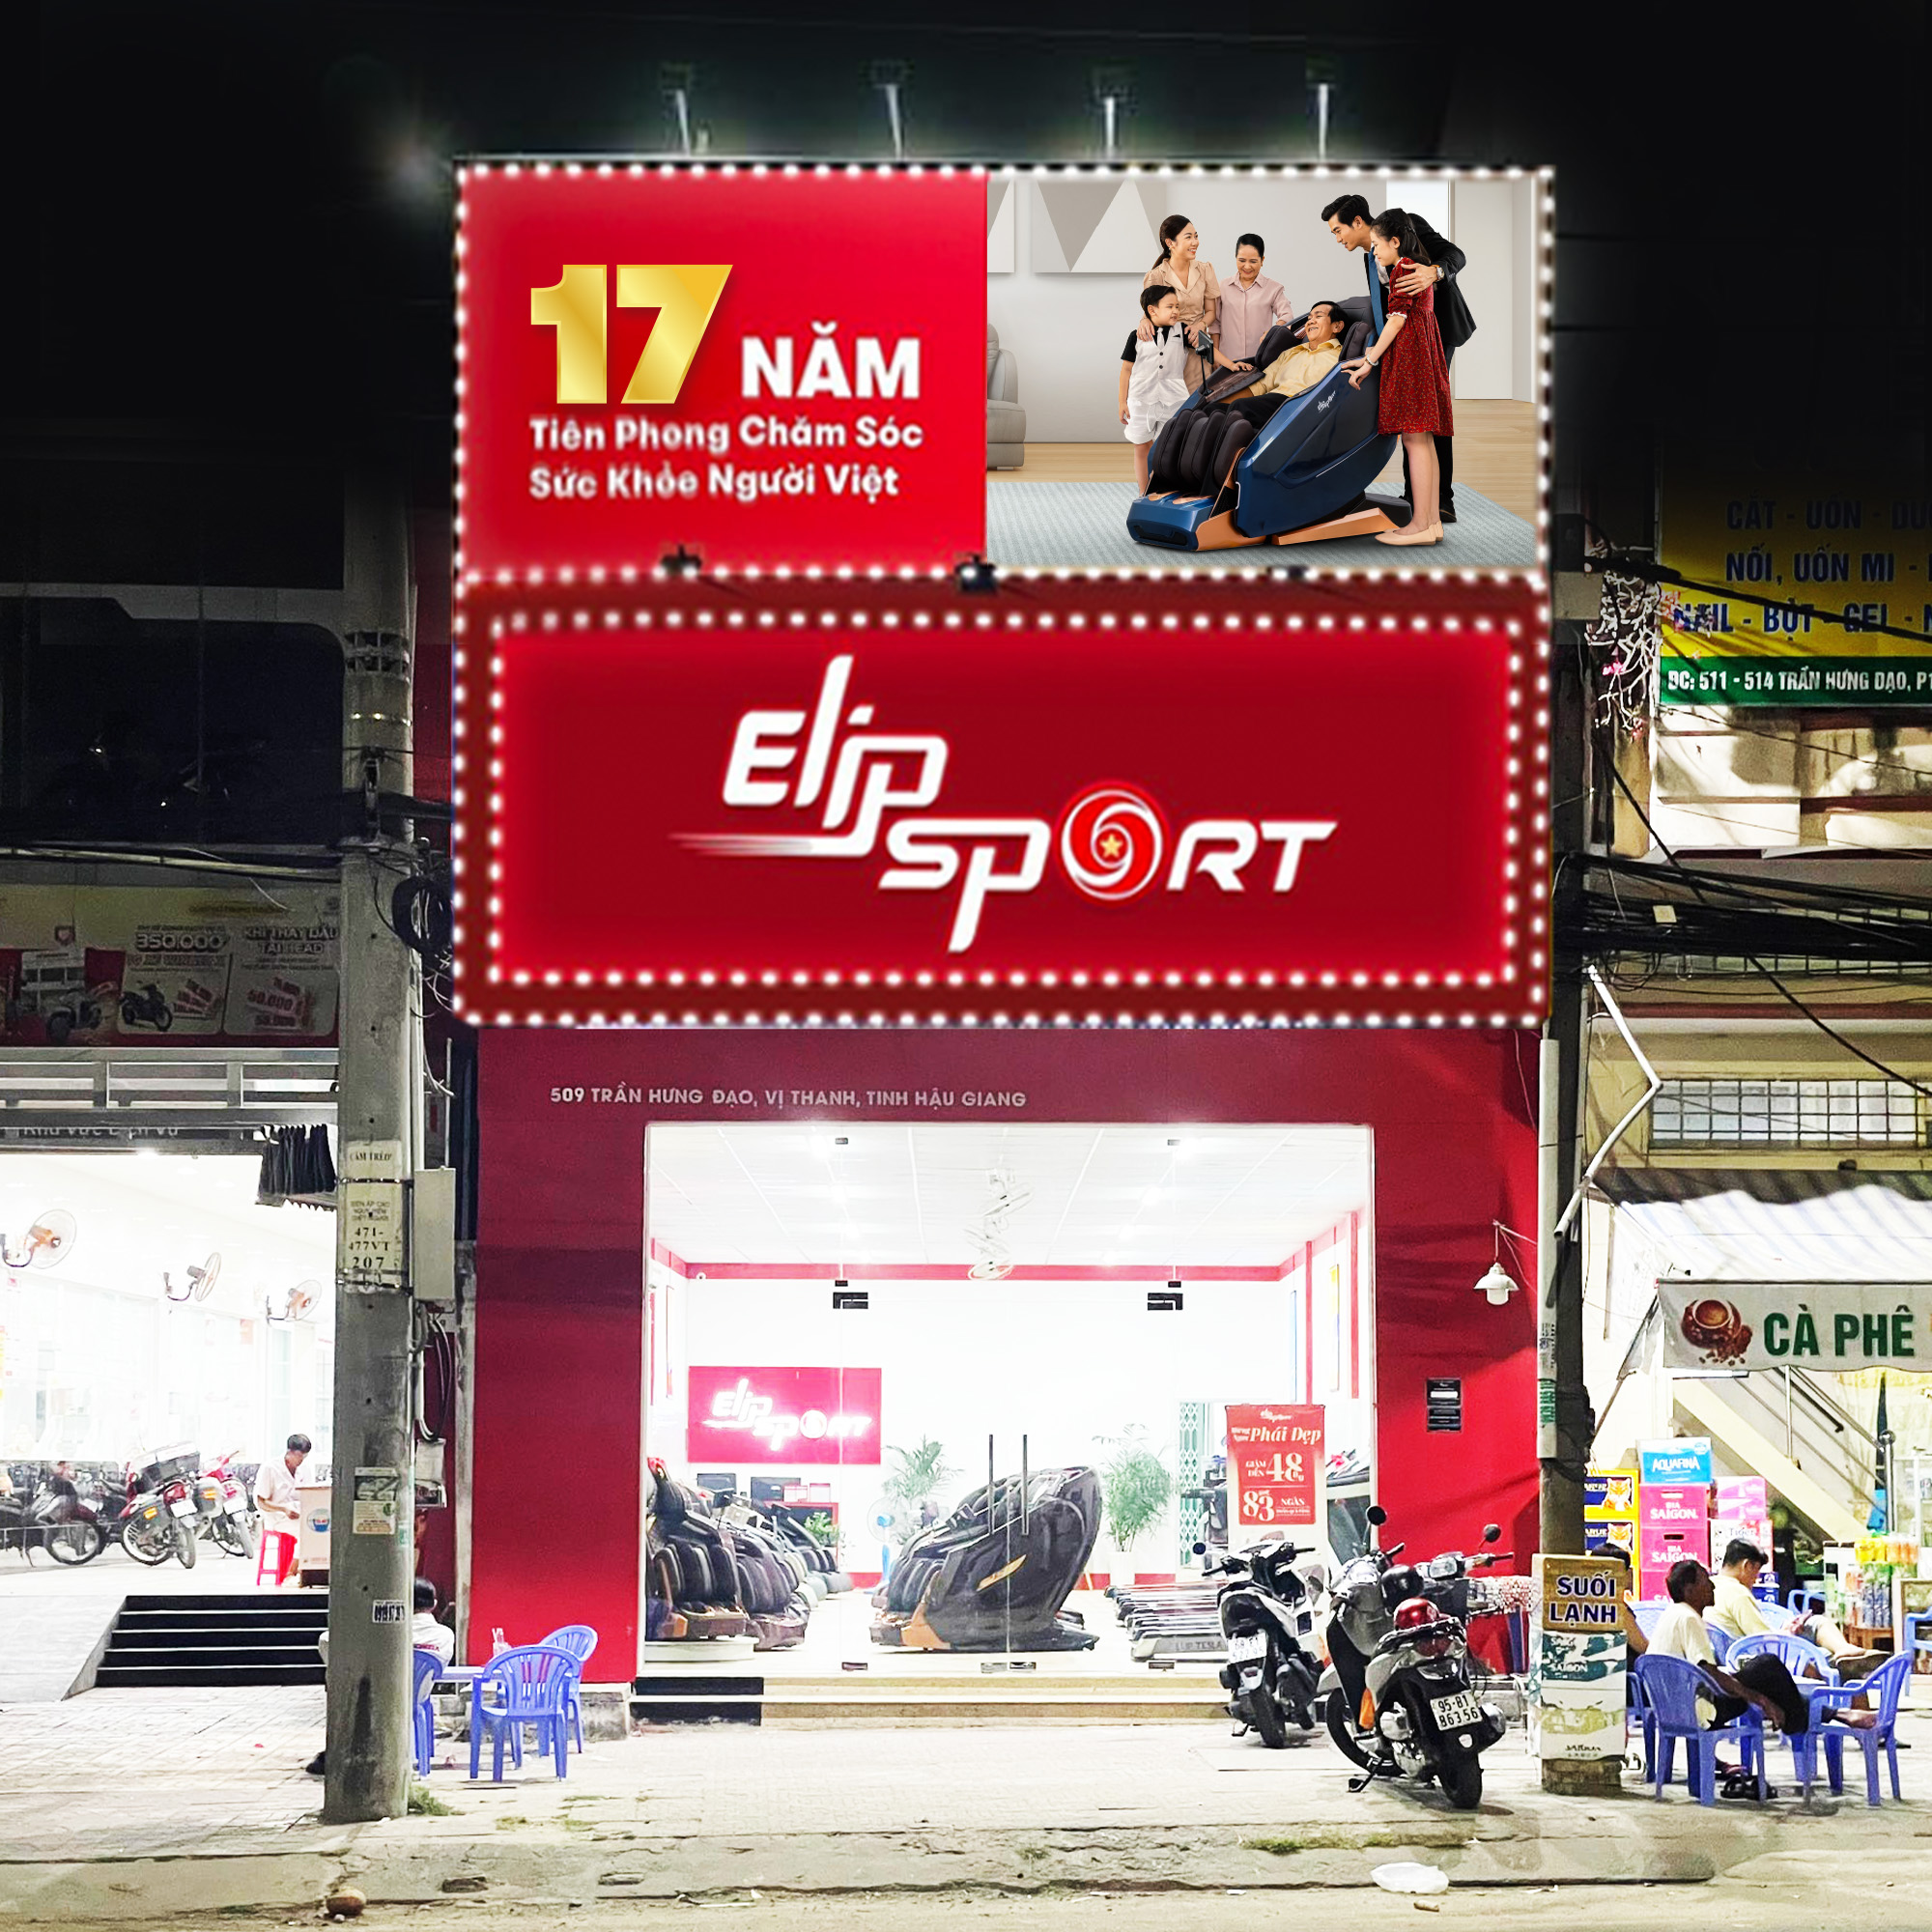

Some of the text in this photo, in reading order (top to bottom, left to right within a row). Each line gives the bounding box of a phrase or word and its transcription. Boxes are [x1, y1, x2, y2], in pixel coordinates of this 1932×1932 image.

[530, 265, 921, 404] 17 NĂM
[529, 415, 923, 455] Tiên Phong Chăm Sóc
[529, 461, 899, 503] Sức Khỏe Người Việt
[1794, 543, 1849, 582] UỐN
[1861, 554, 1893, 582] MI
[1699, 670, 1727, 691] 511
[1744, 670, 1775, 691] 514
[550, 1087, 585, 1103] 509
[590, 1081, 642, 1103] TRẦN
[648, 1087, 703, 1104] HƯNG
[765, 1090, 784, 1109] VỊ
[790, 1090, 861, 1107] THANH,
[915, 1087, 954, 1110] HẬU
[961, 1091, 1027, 1107] GIANG
[353, 1256, 385, 1269] 207
[1764, 1303, 1916, 1357] CÀ PHÊ
[1652, 1456, 1700, 1472] AQUAFINA
[1242, 1491, 1275, 1522] 83
[1557, 1571, 1616, 1598] SUỐI
[1549, 1603, 1617, 1627] LẠNH
